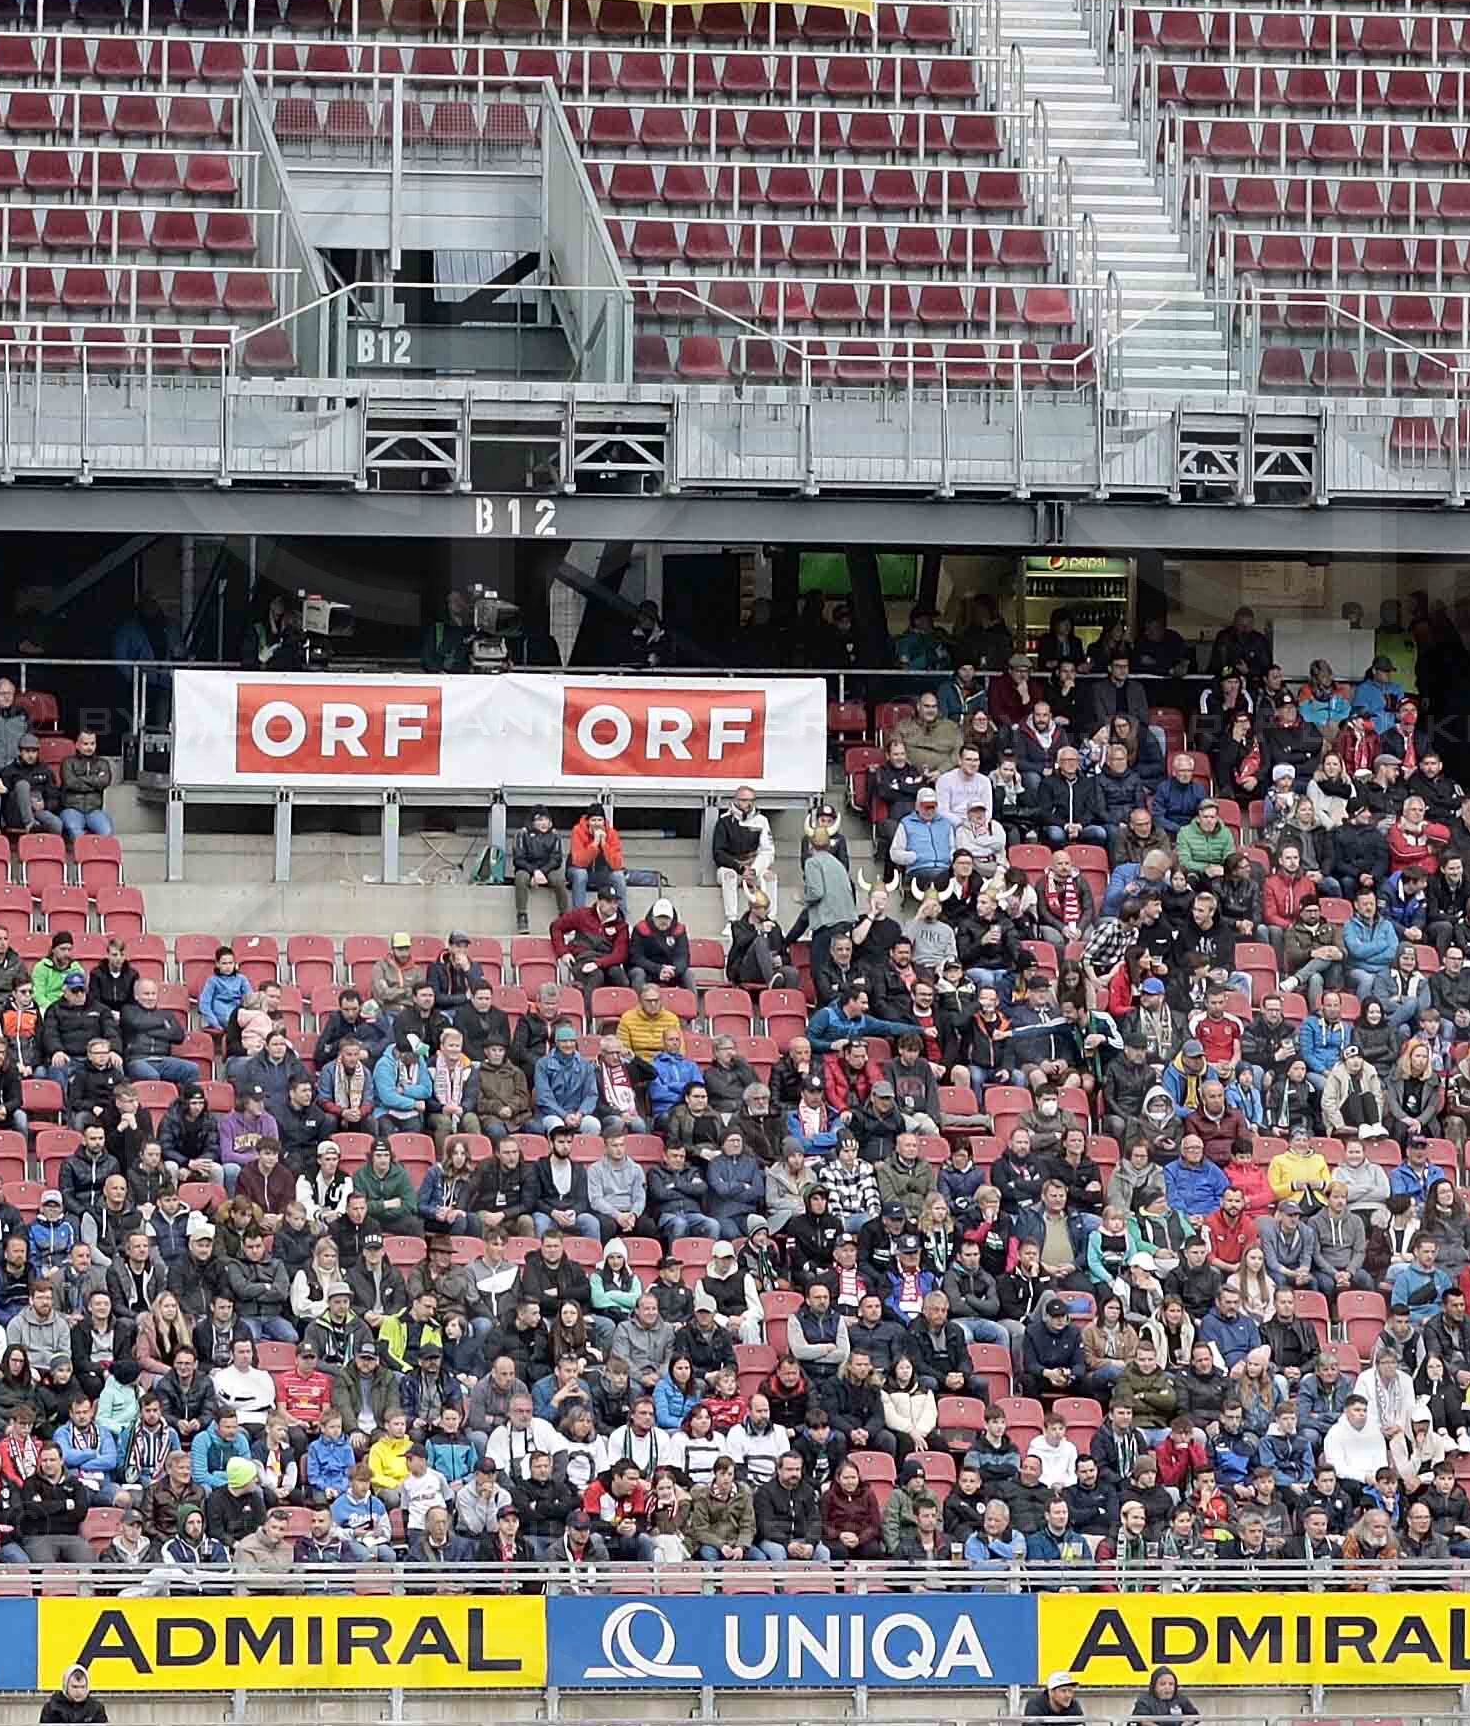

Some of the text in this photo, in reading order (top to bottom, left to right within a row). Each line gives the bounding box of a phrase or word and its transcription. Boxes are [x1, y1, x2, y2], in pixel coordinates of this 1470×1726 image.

[356, 330, 412, 366] B12
[251, 702, 431, 757] ORF
[577, 705, 753, 761] ORF
[76, 1608, 522, 1674] ADMIRAL
[724, 1612, 993, 1680] UNIQA
